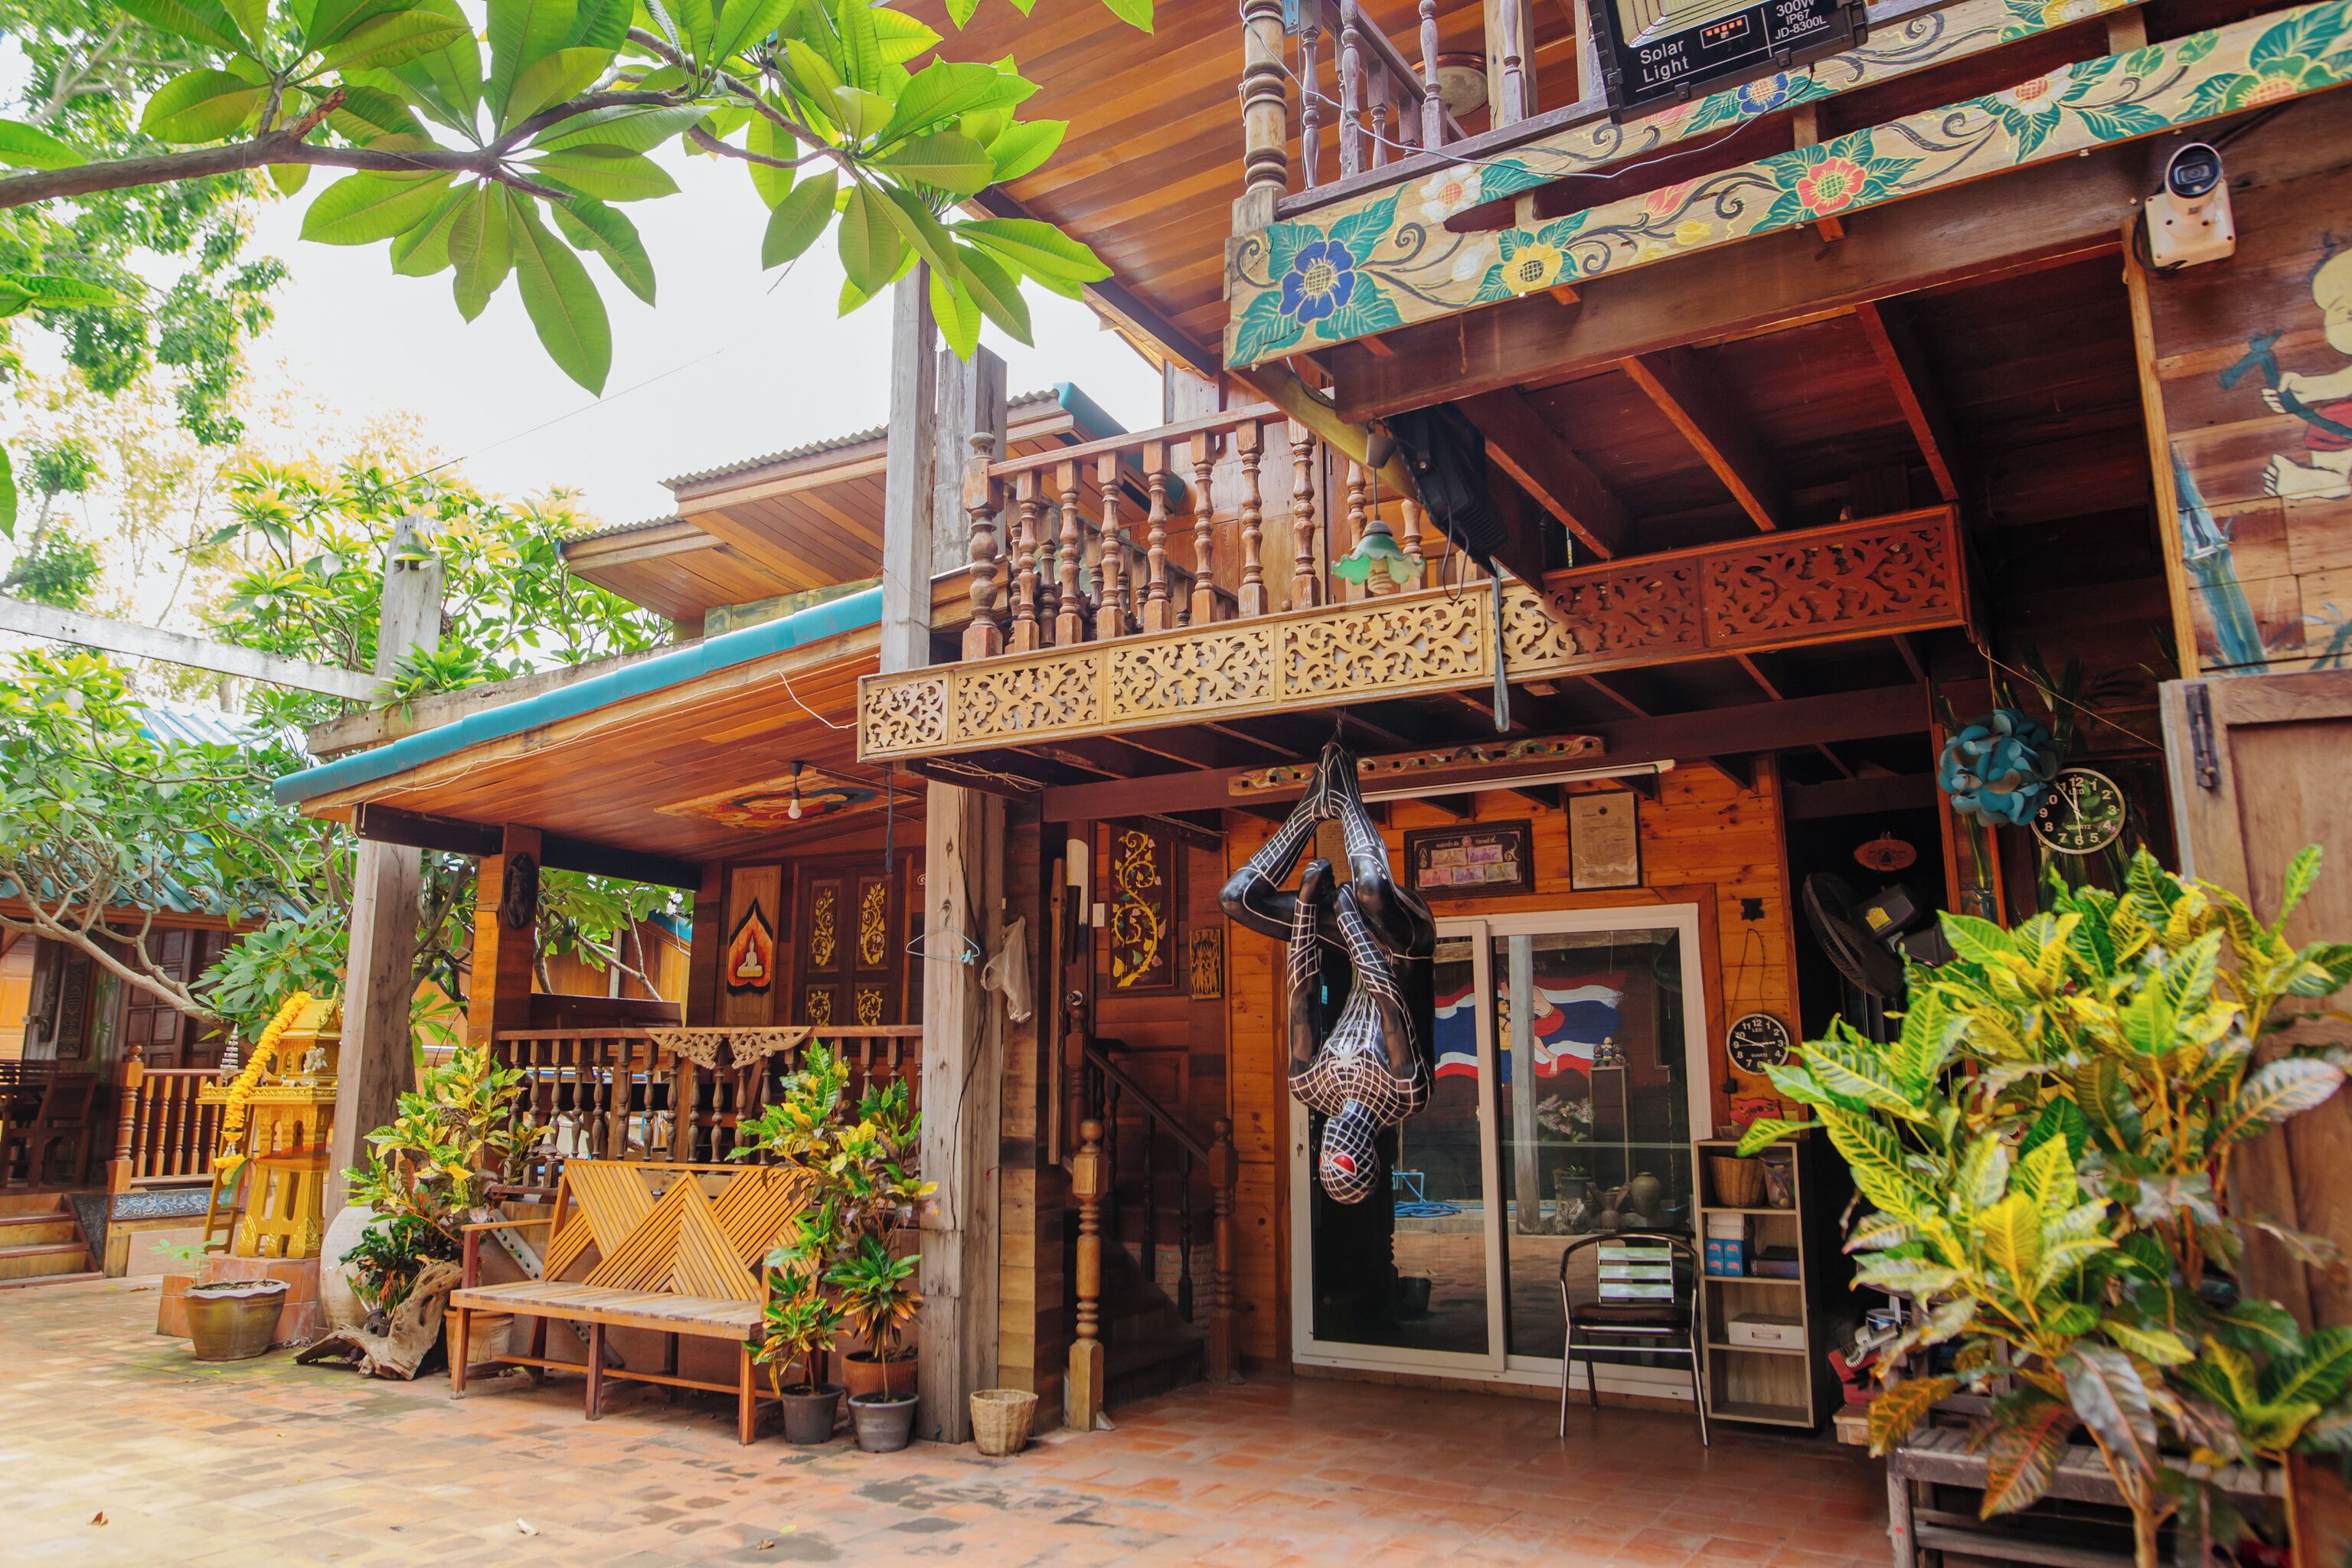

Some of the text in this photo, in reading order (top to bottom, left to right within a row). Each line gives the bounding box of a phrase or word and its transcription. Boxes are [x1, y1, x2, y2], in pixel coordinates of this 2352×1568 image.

[1785, 8, 1810, 25] IP67
[1775, 15, 1827, 40] JD-8300L
[1640, 40, 1684, 64] Solar
[1643, 56, 1689, 83] Light
[2069, 777, 2084, 787] 12
[2089, 781, 2097, 791] 1
[2102, 790, 2112, 800] 2
[2039, 808, 2048, 818] 9
[2107, 805, 2118, 815] 3
[2045, 822, 2054, 832] 8
[2102, 820, 2111, 831] 4
[2058, 833, 2067, 844] 7
[2074, 835, 2084, 845] 6
[2090, 833, 2099, 843] 5
